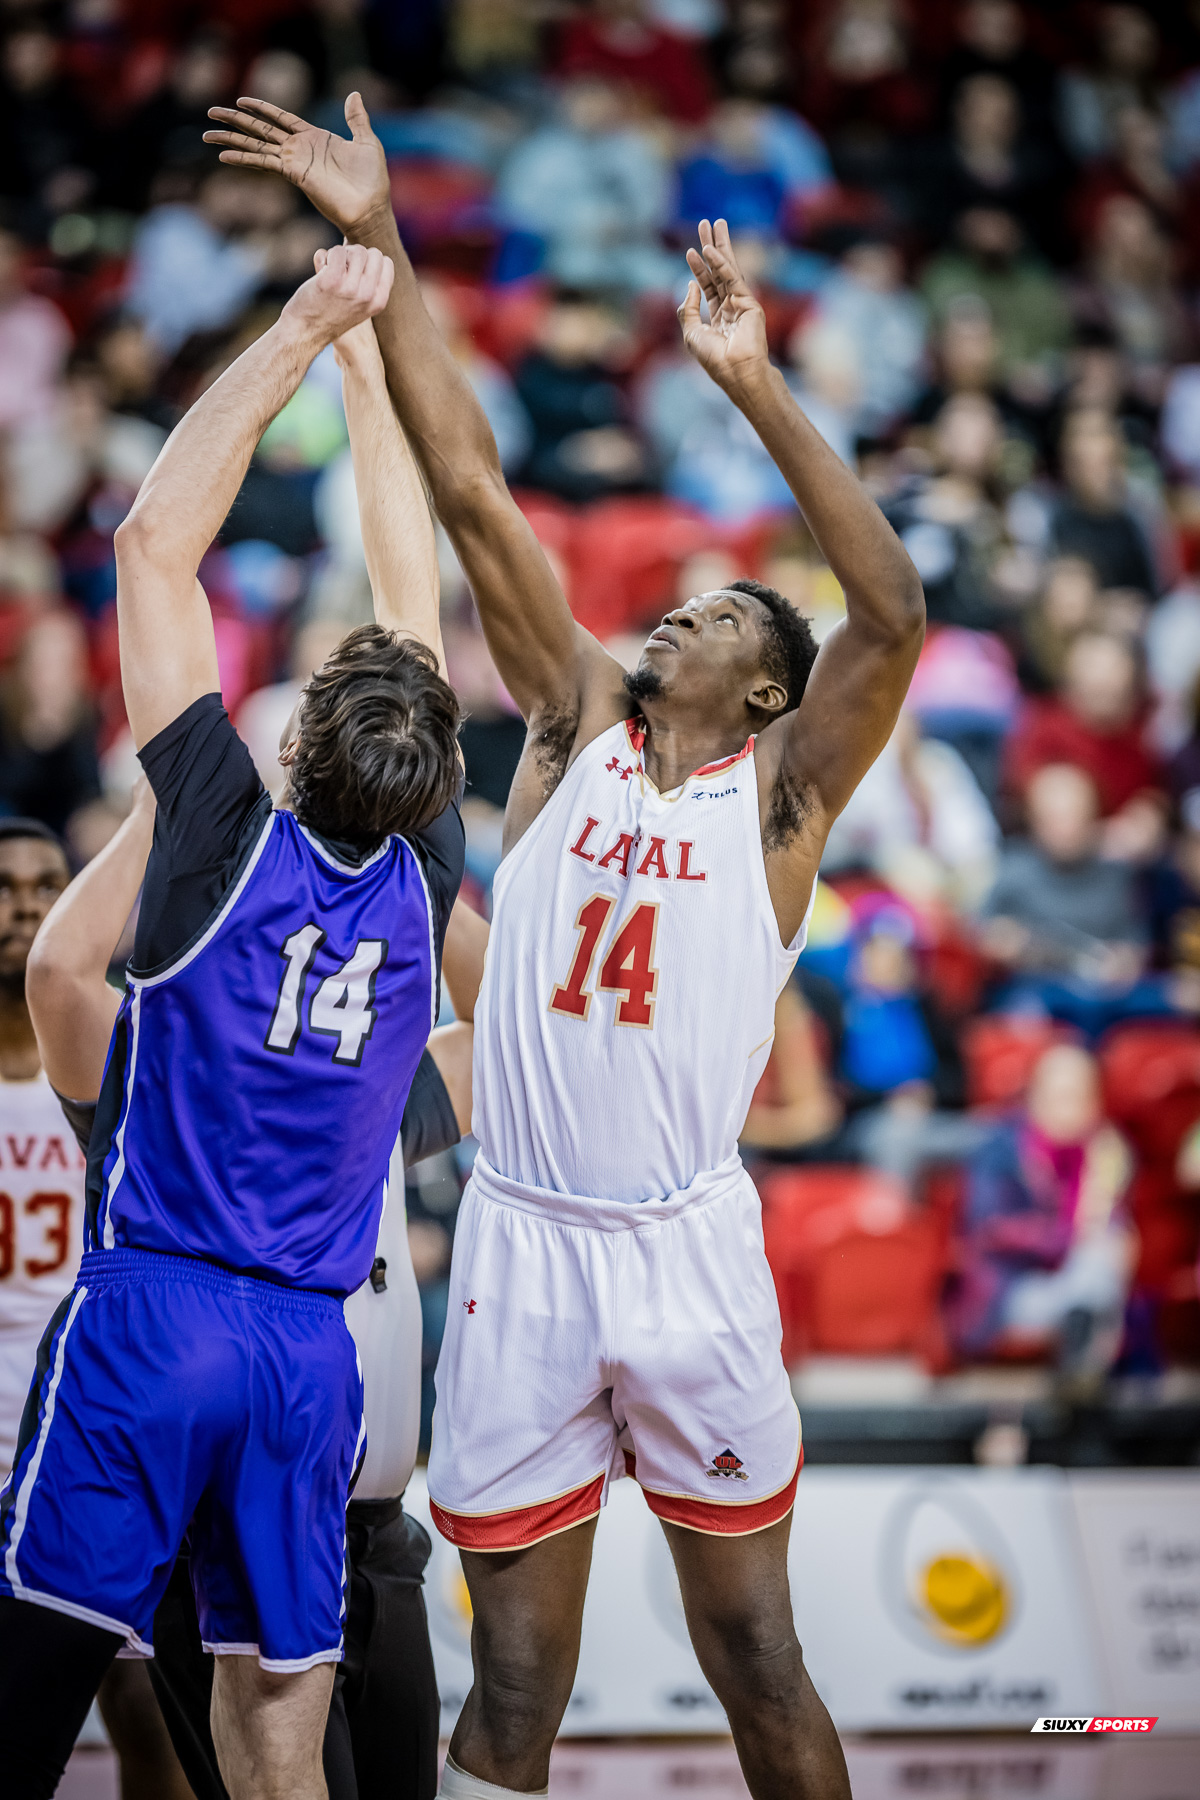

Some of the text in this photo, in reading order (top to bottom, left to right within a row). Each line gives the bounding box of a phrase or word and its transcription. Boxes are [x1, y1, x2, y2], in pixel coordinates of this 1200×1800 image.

[709, 787, 738, 799] TELUS
[568, 815, 708, 883] LAAL
[263, 921, 390, 1068] 14
[547, 892, 660, 1030] 14
[715, 1456, 742, 1469] UL
